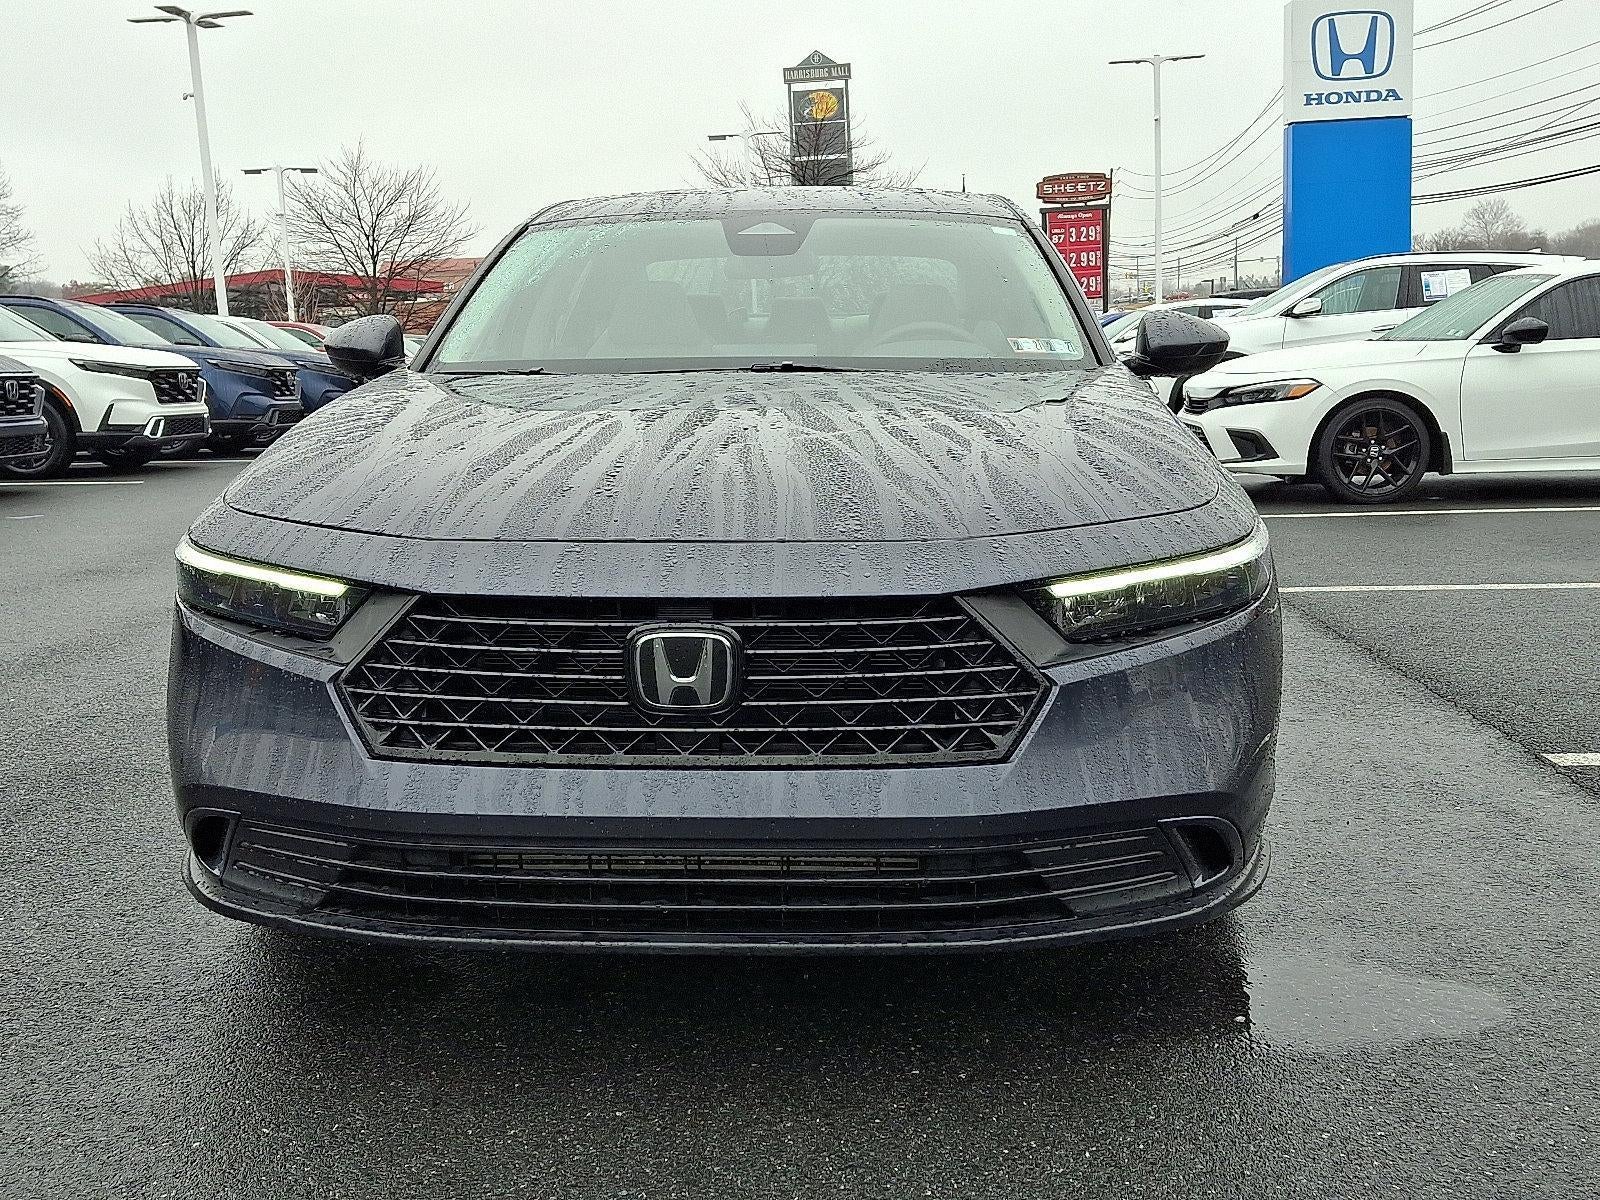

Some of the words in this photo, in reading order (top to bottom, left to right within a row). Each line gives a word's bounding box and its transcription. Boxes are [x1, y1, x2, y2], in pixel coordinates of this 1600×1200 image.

[785, 67, 829, 80] HARRISBURG
[831, 66, 850, 77] MALL
[1303, 88, 1404, 107] HONDA
[1043, 181, 1106, 194] SHEETZ
[1051, 234, 1065, 244] 87
[1080, 276, 1096, 292] 29
